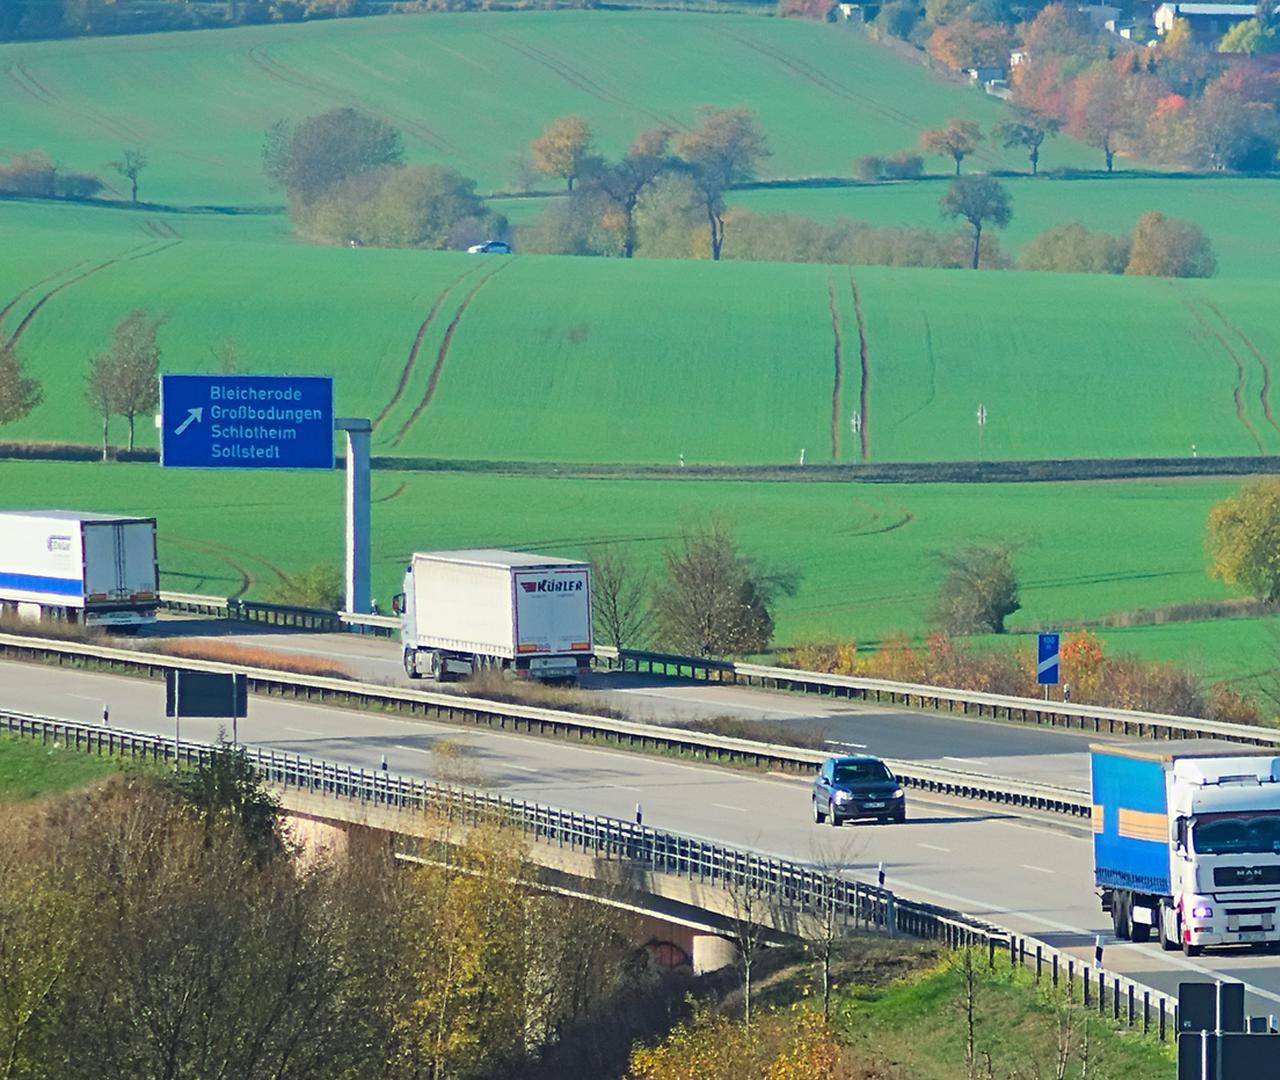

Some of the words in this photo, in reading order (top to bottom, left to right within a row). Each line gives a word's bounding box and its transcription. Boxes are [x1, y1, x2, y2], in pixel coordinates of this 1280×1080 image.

[210, 386, 302, 400] Bleicherode
[211, 405, 322, 423] Großbodungen
[211, 425, 297, 439] Schlotheim
[211, 444, 281, 459] Sollstedt
